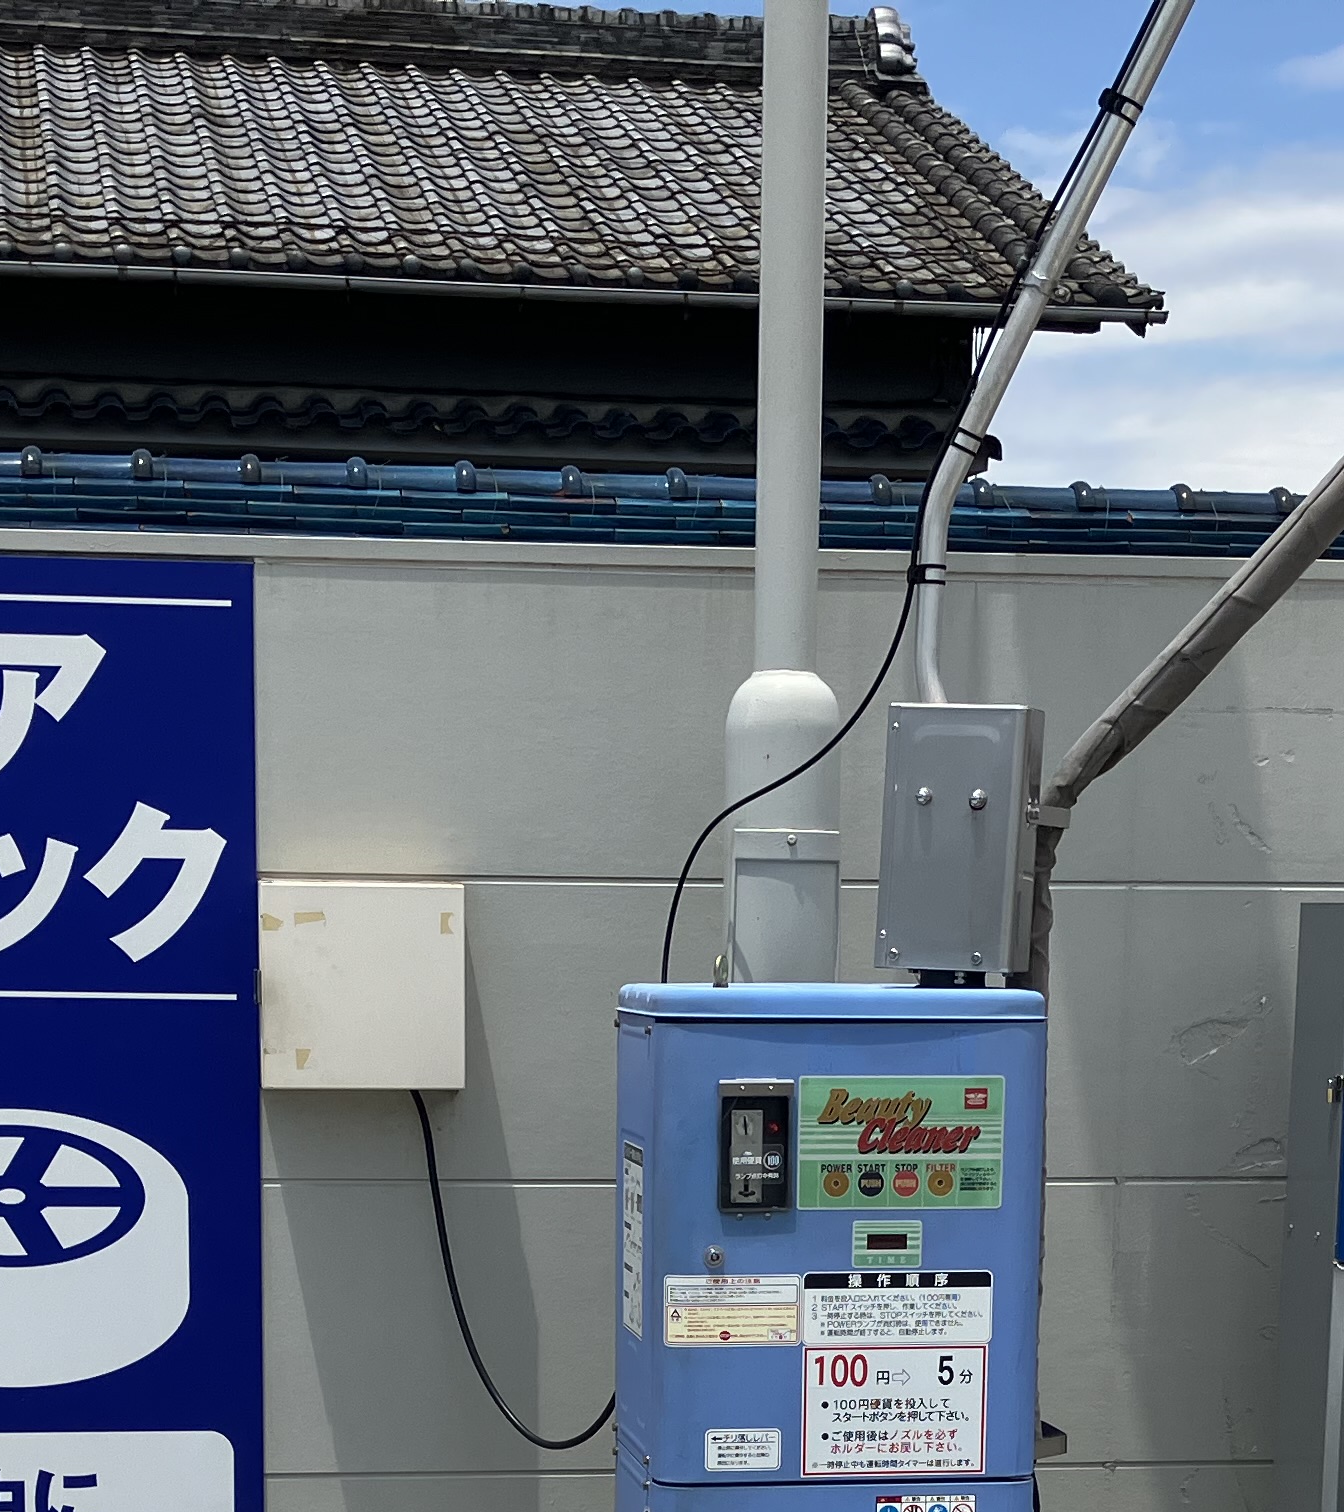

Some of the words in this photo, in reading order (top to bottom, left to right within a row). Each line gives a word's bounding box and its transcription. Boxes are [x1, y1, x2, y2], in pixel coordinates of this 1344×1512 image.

[817, 1087, 932, 1127] Beauty
[857, 1116, 982, 1155] Cleaner
[820, 1163, 853, 1174] POWER
[857, 1163, 886, 1174] START
[894, 1163, 918, 1174] STOP
[925, 1163, 956, 1173] FILTER
[866, 1256, 907, 1264] TIME
[937, 1355, 954, 1386] 5
